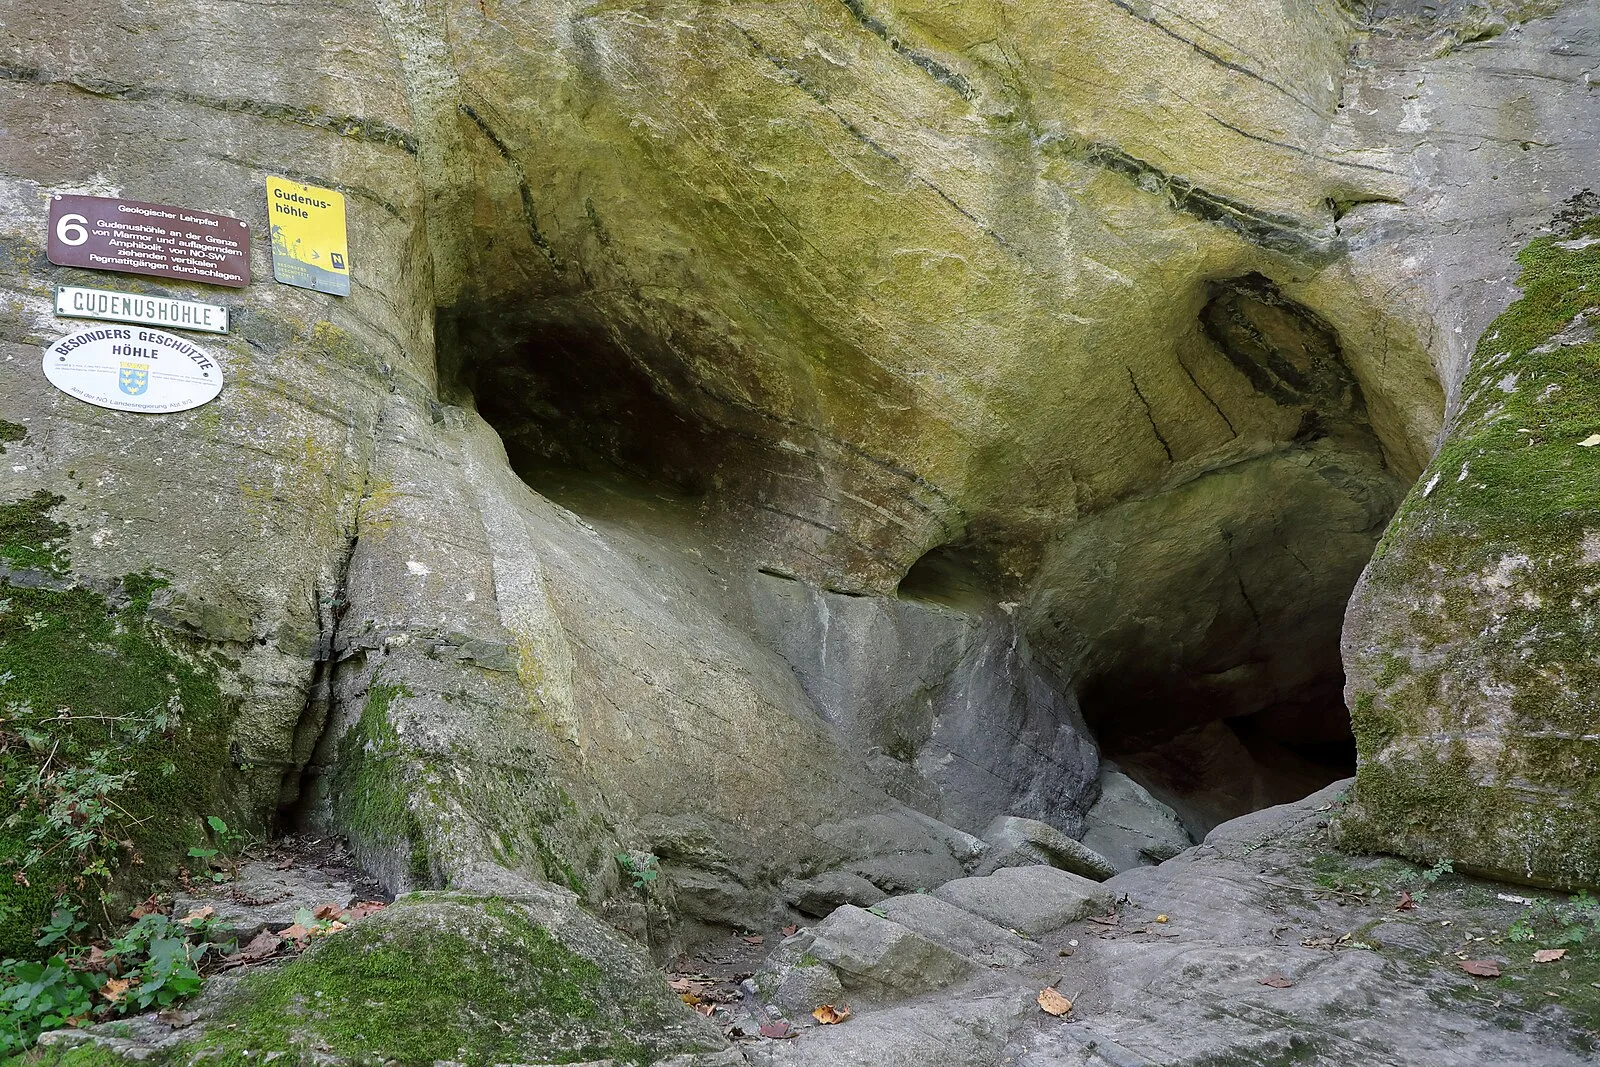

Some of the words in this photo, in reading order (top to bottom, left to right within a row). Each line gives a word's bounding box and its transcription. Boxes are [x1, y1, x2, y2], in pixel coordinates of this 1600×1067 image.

[274, 188, 332, 209] Gudenus-
[275, 202, 309, 219] höhle
[117, 204, 177, 220] Geologischer
[179, 213, 219, 228] Lehrpfad
[56, 213, 89, 247] 6
[96, 219, 166, 235] Gudenushöhle
[169, 230, 182, 238] an
[185, 231, 202, 241] der
[205, 234, 238, 247] Grenze
[91, 229, 110, 237] von
[113, 229, 153, 242] Marmor
[156, 236, 176, 245] und
[178, 239, 243, 257] auflagerndem
[108, 238, 165, 253] Amphibolit,
[168, 247, 187, 256] von
[189, 248, 226, 262] NO-SW
[89, 253, 169, 270] Pegmatitgängen
[172, 263, 243, 281] durchschlagen.
[117, 248, 167, 261] ziehenden
[170, 255, 218, 269] vertikalen
[73, 291, 213, 327] GUDENUSHÖHLE
[55, 329, 131, 357] BESONDERS
[138, 331, 214, 371] GESCHÜTZTE
[112, 344, 159, 359] HÖHLE
[70, 386, 83, 395] Amt
[83, 392, 95, 400] der
[109, 399, 168, 409] Landesregierung
